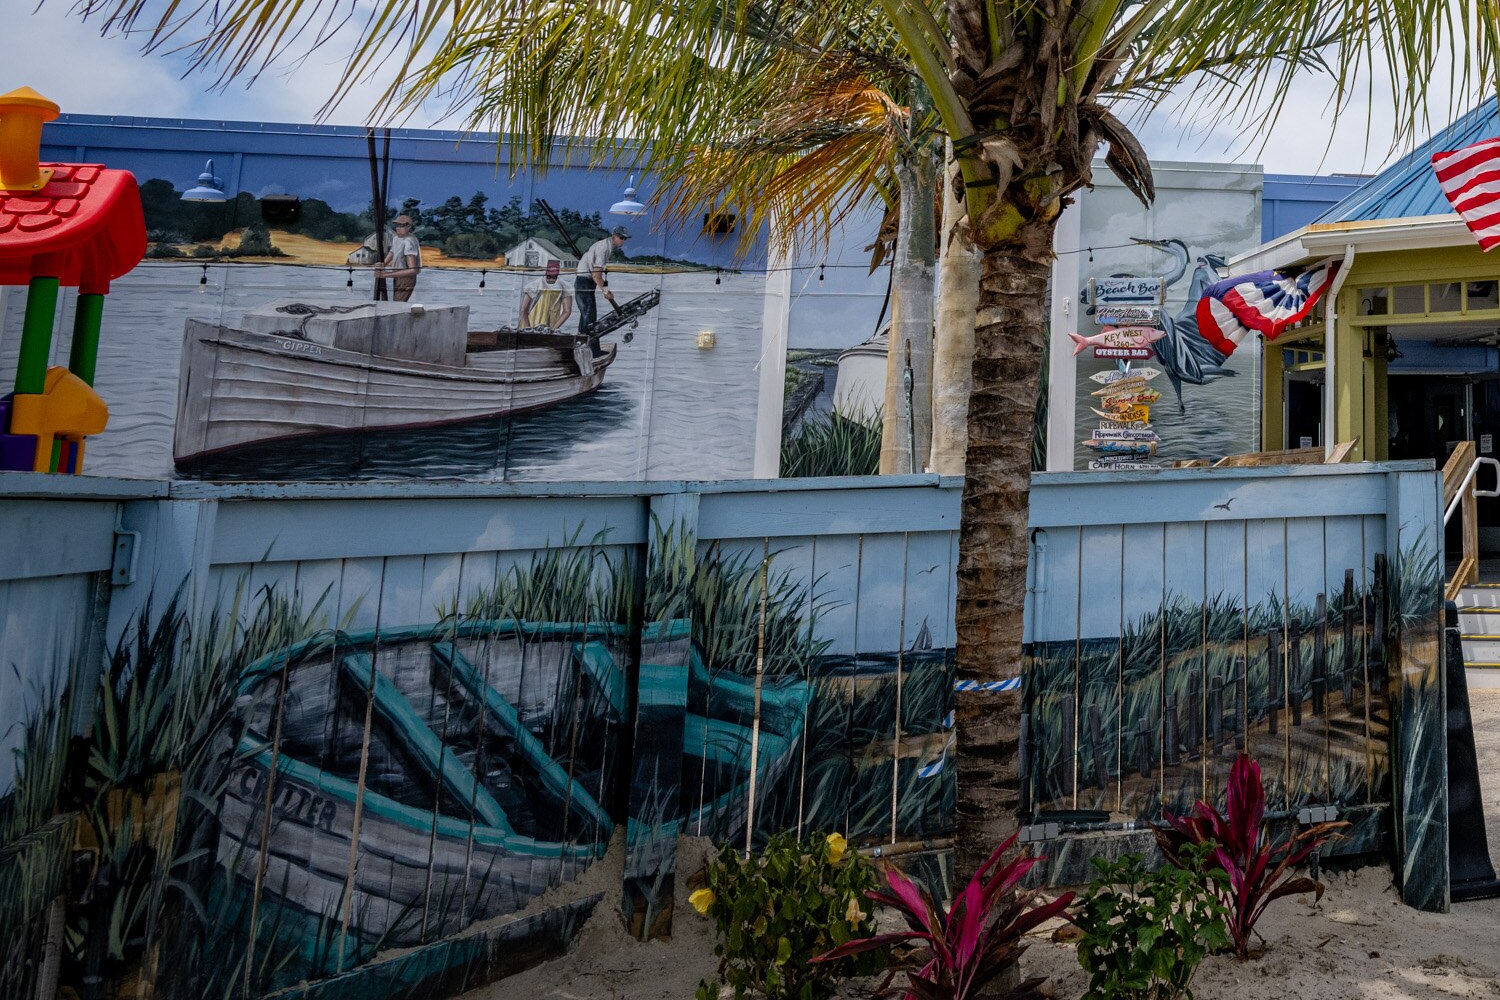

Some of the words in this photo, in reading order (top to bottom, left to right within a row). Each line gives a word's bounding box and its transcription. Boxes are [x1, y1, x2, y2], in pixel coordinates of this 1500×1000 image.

[1095, 282, 1137, 298] Beach
[1138, 283, 1161, 295] Bar
[1104, 331, 1121, 344] KEY
[1122, 329, 1143, 338] WEST
[283, 340, 322, 354] GIPPER
[1095, 348, 1130, 356] OYSTER
[1136, 394, 1155, 402] Bar
[1104, 409, 1146, 420] MERCHANDISE
[1100, 421, 1136, 429] ROPEWALK
